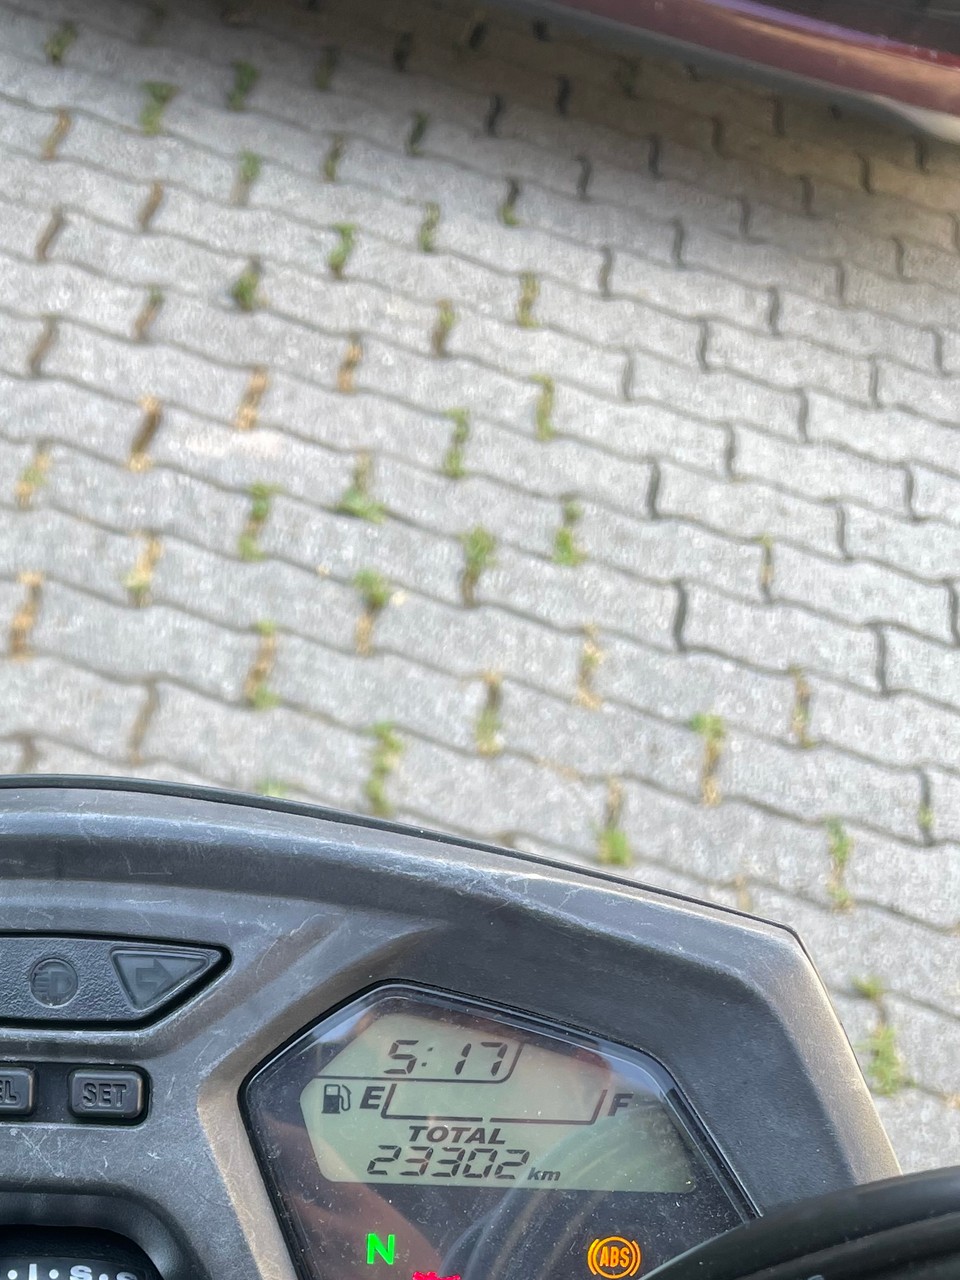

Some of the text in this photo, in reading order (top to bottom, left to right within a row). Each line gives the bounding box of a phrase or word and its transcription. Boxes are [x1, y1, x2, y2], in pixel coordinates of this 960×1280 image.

[383, 1039, 507, 1075] 5:17
[82, 1083, 127, 1107] SET
[360, 1086, 634, 1117] E F
[409, 1126, 506, 1145] TOTAL
[366, 1145, 561, 1182] 23302 km
[366, 1233, 395, 1265] N
[599, 1246, 630, 1268] ABS
